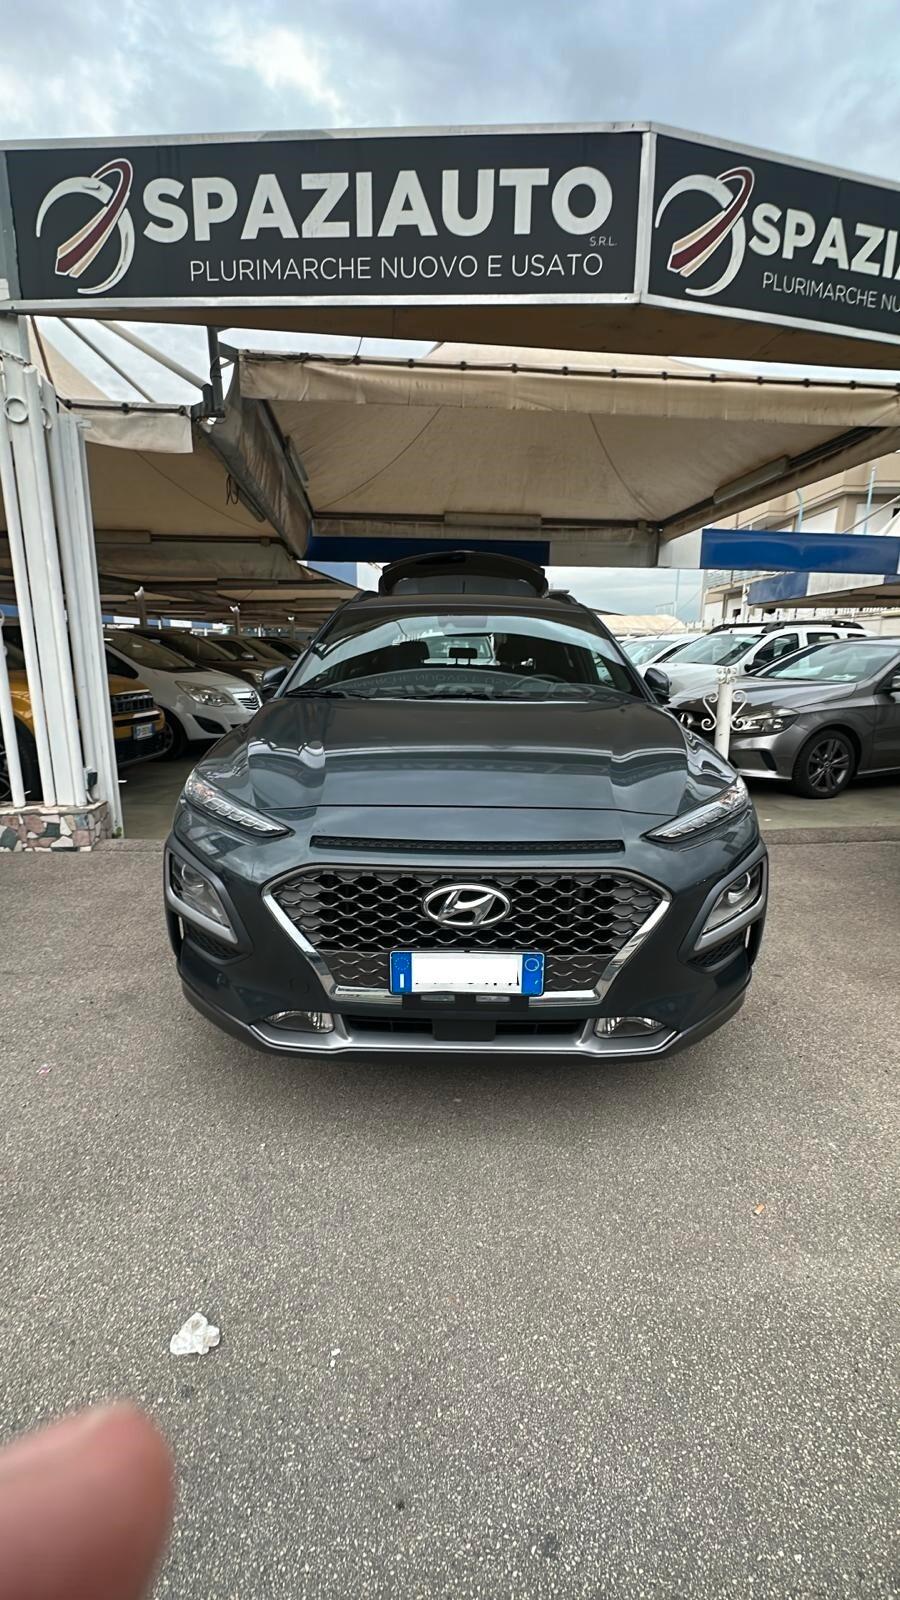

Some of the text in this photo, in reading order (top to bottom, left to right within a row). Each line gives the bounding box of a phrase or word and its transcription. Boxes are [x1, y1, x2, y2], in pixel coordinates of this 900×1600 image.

[143, 166, 613, 243] SPAZIAUTO
[589, 236, 617, 246] S.R.L.
[748, 203, 900, 280] SPAZI
[190, 252, 603, 281] PLURIMARCHE NUOVO E USATO
[762, 271, 878, 309] PLURIMARCHE
